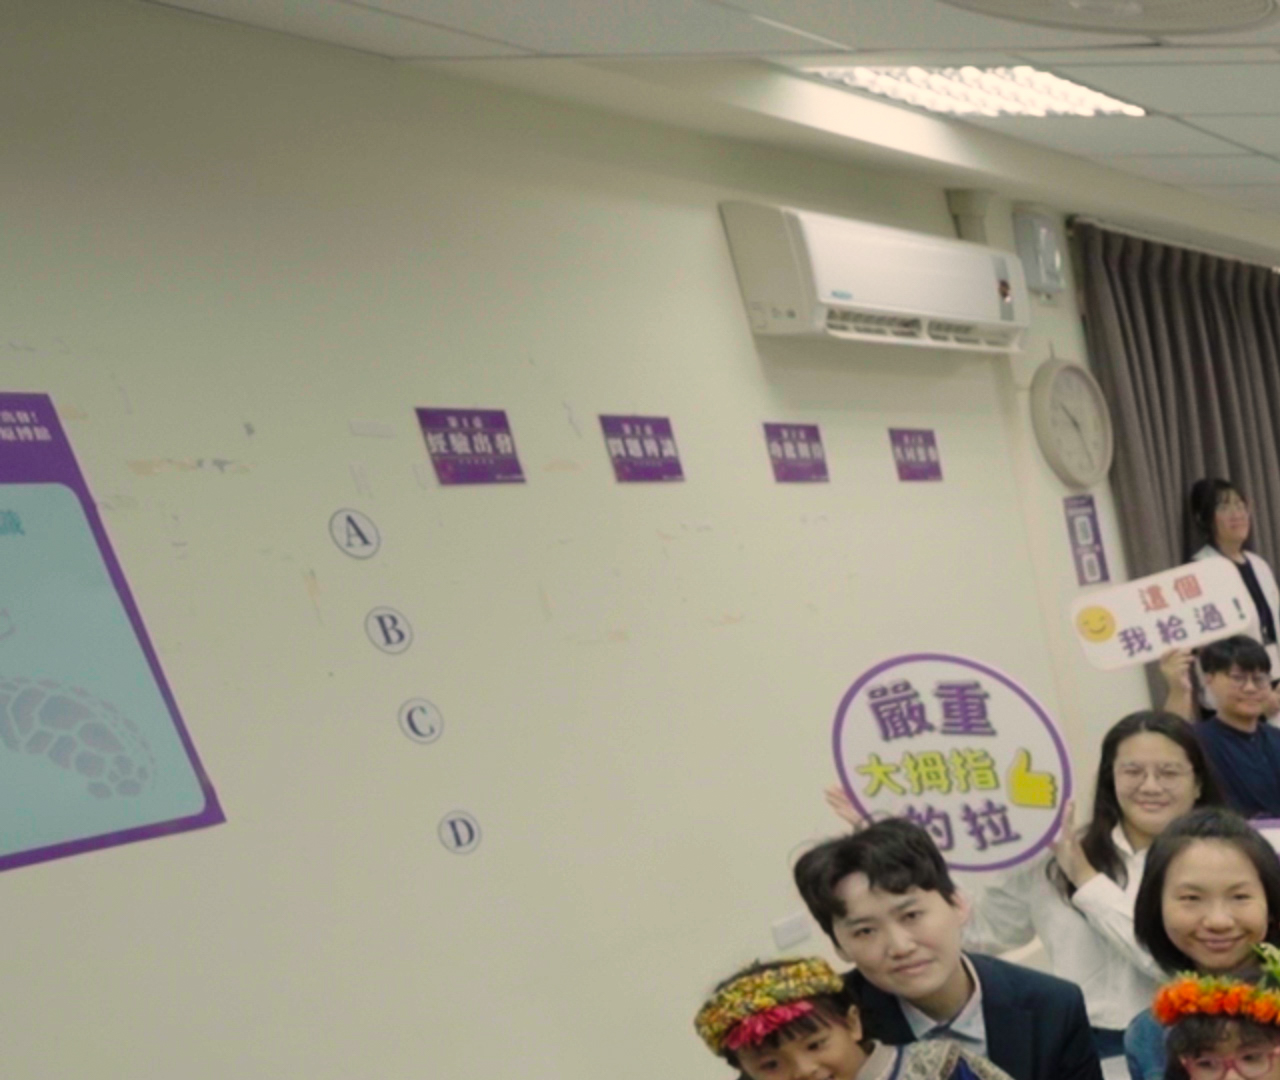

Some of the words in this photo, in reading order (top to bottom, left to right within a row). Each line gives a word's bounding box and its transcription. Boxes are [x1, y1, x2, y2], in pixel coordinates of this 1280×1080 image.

[346, 515, 372, 548] A
[1138, 574, 1202, 613] 這個
[376, 613, 405, 646] B
[1118, 597, 1246, 657] 我給過!
[406, 705, 435, 738] C
[867, 680, 998, 743] 嚴重
[854, 747, 1000, 798] 大拇指
[448, 817, 475, 847] D
